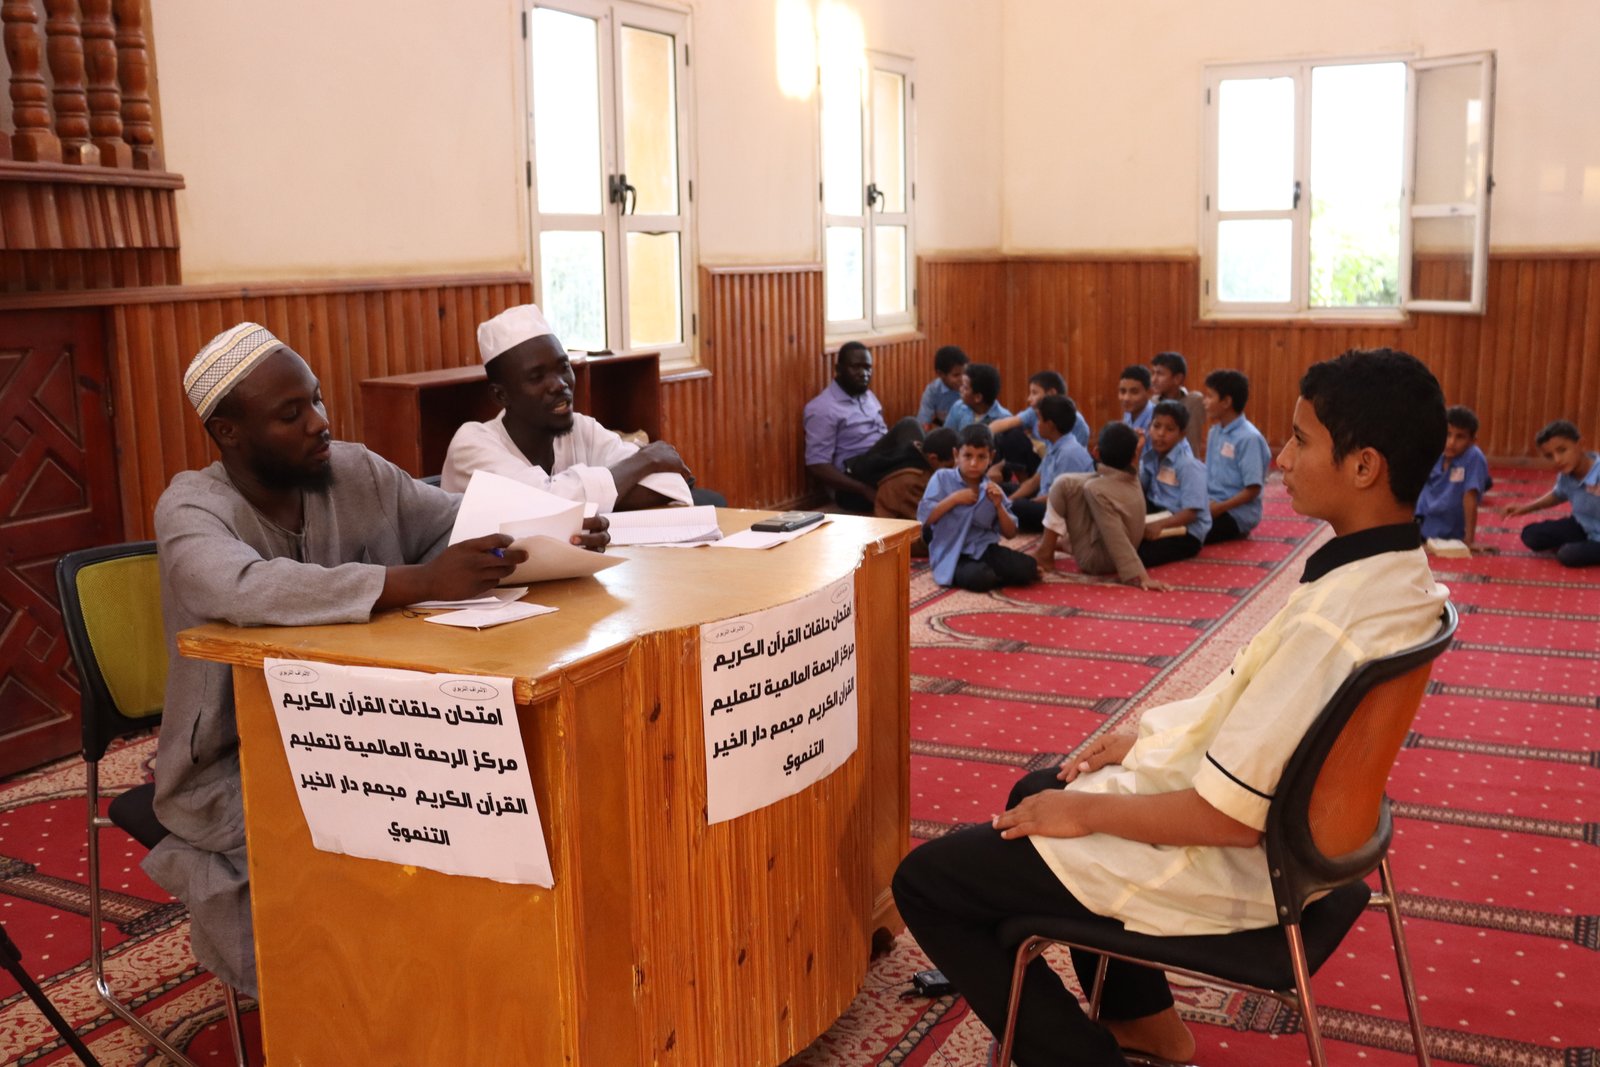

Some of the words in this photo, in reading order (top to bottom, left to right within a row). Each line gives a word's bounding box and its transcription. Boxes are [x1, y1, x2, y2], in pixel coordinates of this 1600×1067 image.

[831, 601, 851, 631] امتحان
[803, 617, 830, 640] حلقات
[767, 627, 801, 657] القرآن
[713, 639, 764, 671] الكريم
[812, 649, 839, 677] الرحمة
[840, 642, 854, 668] مركز
[764, 665, 810, 697] العالمية
[283, 691, 335, 711] الكريم
[340, 692, 386, 716] القرآن
[389, 699, 441, 720] حلقات
[710, 683, 761, 716] لتعليم
[808, 690, 838, 724] الكريم
[445, 705, 503, 725] امتحان
[770, 714, 803, 740] مجمع
[290, 732, 341, 751] لتعليم
[344, 736, 411, 758] العالمية
[713, 729, 747, 759] الخير
[751, 726, 766, 747] دار
[415, 744, 468, 768] الرحمة
[474, 751, 518, 774] مركز
[783, 739, 824, 776] التنموي
[301, 772, 335, 790] الخير
[340, 776, 359, 793] دار
[363, 781, 407, 801] مجمع
[416, 788, 472, 809] الكريم
[477, 792, 528, 817] القرآن
[388, 822, 450, 846] التنموي
